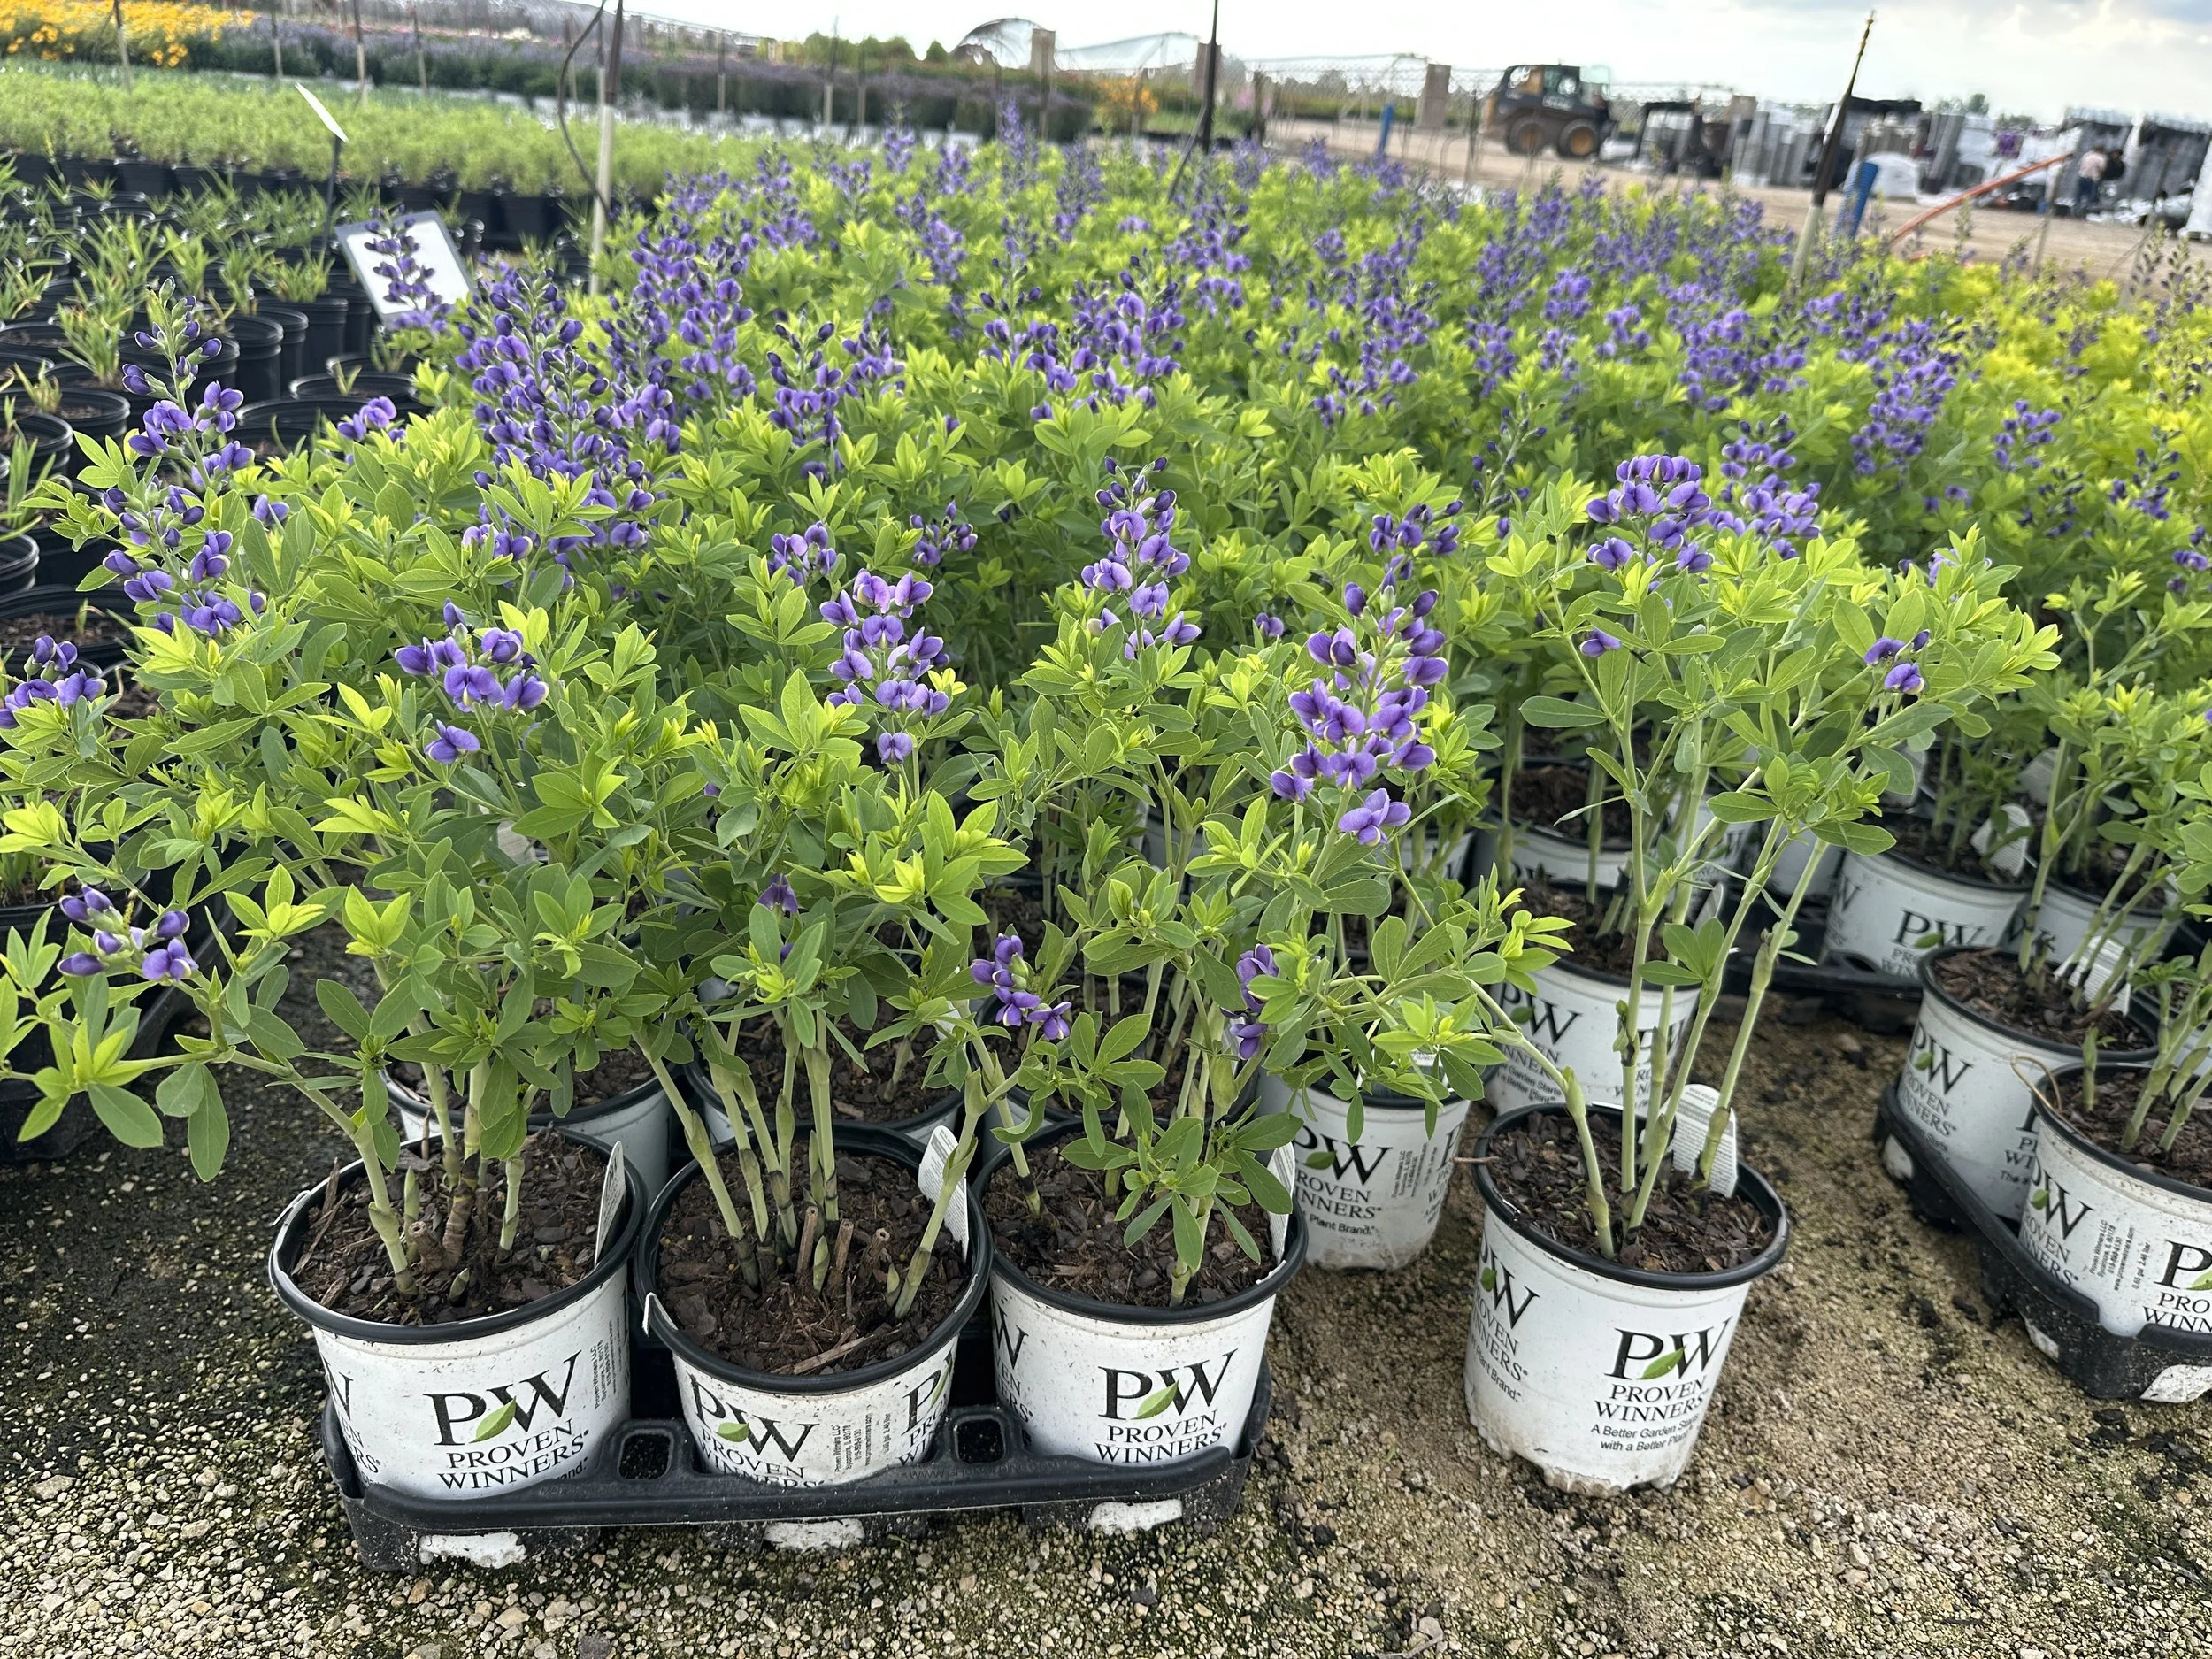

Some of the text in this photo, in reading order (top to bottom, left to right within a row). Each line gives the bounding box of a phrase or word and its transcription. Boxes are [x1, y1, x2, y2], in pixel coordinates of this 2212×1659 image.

[1909, 1075, 1952, 1117] ROVEN
[1294, 1185, 1377, 1219] INNERS
[1296, 1168, 1371, 1203] ROVEN
[1310, 1213, 1336, 1230] Plant
[2153, 1239, 2212, 1290] P
[1476, 1286, 1519, 1356] ROVEN
[2142, 1305, 2212, 1333] WINN
[2157, 1291, 2211, 1314] PRO
[1604, 1316, 1733, 1380] PW
[422, 1349, 582, 1447] PW
[1097, 1348, 1239, 1421] PW
[1609, 1375, 1707, 1402] PROVEN
[686, 1371, 820, 1463] PW
[1108, 1409, 1218, 1443] PROVEN
[1594, 1394, 1704, 1422] WINNERS
[446, 1417, 572, 1469] PROVEN
[1094, 1426, 1223, 1463] WINNERS
[1590, 1424, 1601, 1433] A
[1602, 1425, 1638, 1439] Better
[1640, 1425, 1676, 1438] Garden
[1601, 1440, 1623, 1451] with
[1636, 1440, 1666, 1451] Better
[437, 1433, 584, 1489] WINNERS
[701, 1426, 804, 1479] PROVEN
